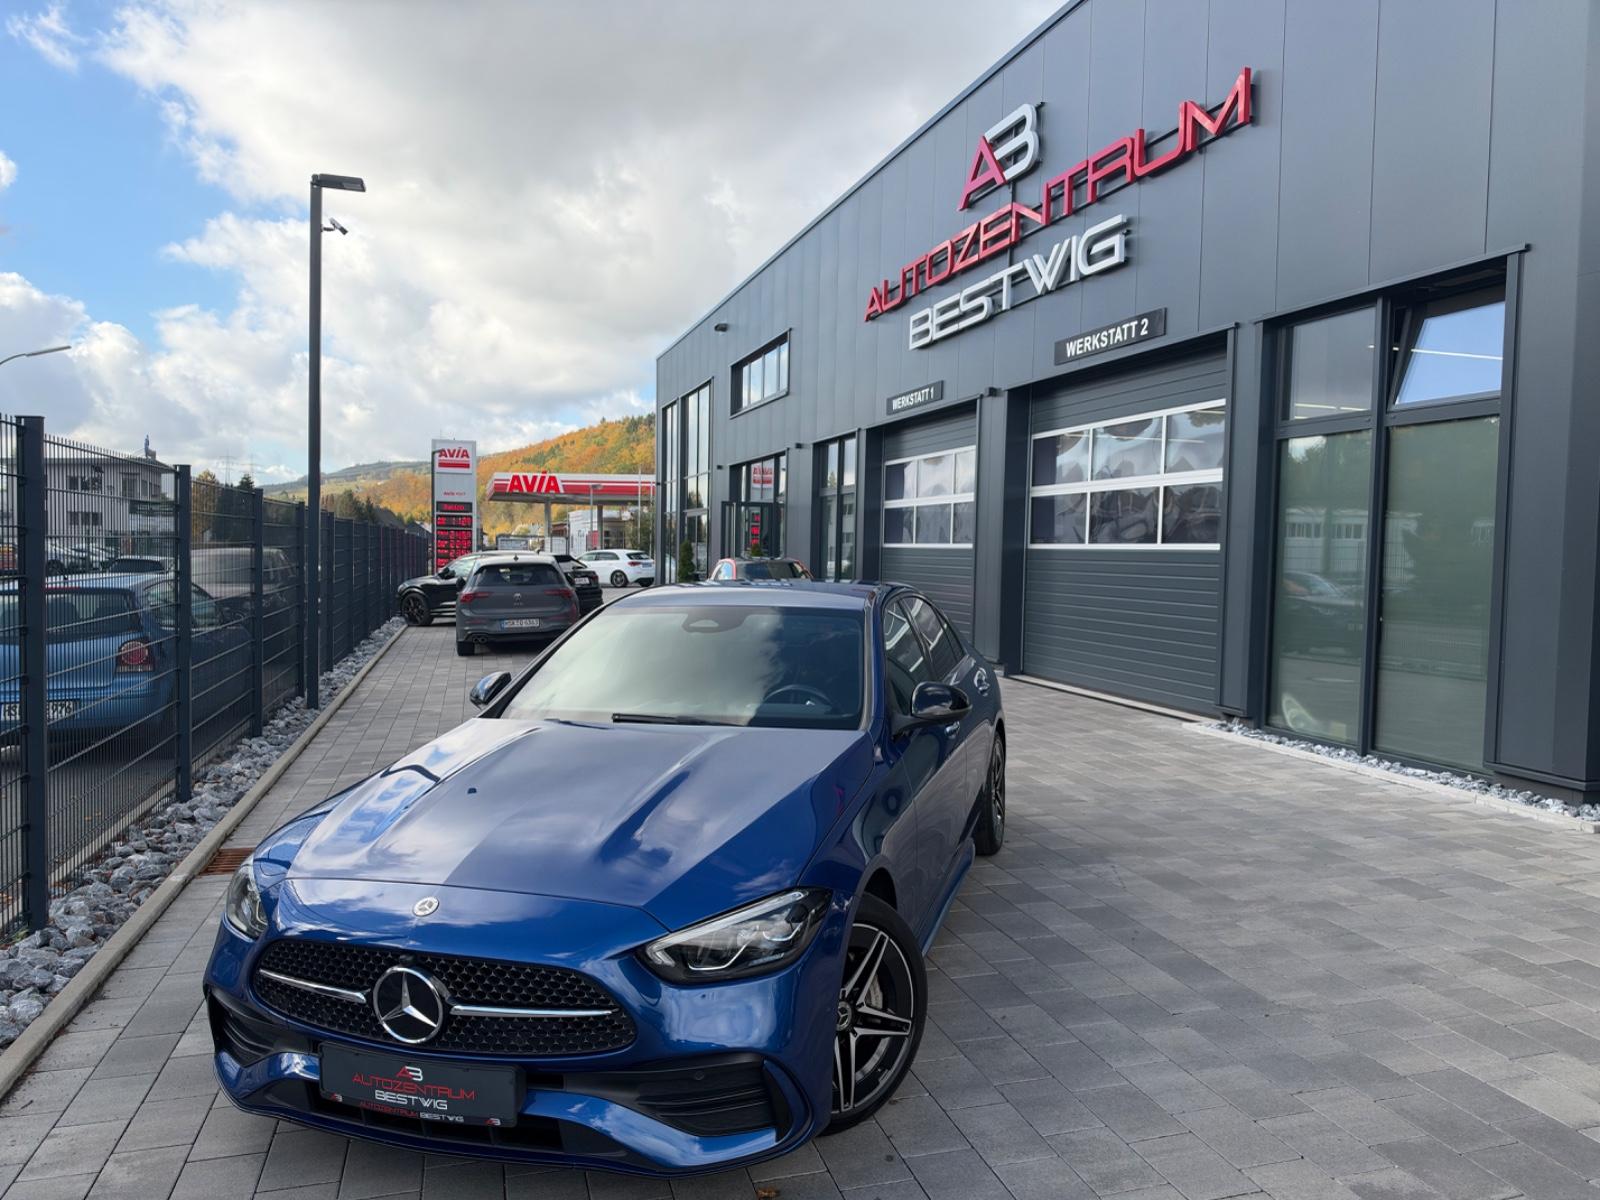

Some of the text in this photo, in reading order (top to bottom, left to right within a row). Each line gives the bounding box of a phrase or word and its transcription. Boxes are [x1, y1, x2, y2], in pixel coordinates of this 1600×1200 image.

[864, 66, 1252, 322] AUTOZENTRUM
[908, 213, 1127, 350] BESTWIG
[1066, 318, 1149, 358] WERKSTATT 2
[892, 386, 935, 411] WERKSTATT 1
[352, 1072, 476, 1101] AUTOZENTRUM
[374, 1089, 449, 1110] BESTWIG
[359, 1101, 465, 1123] AUTOZENTRUM BESTWIG
